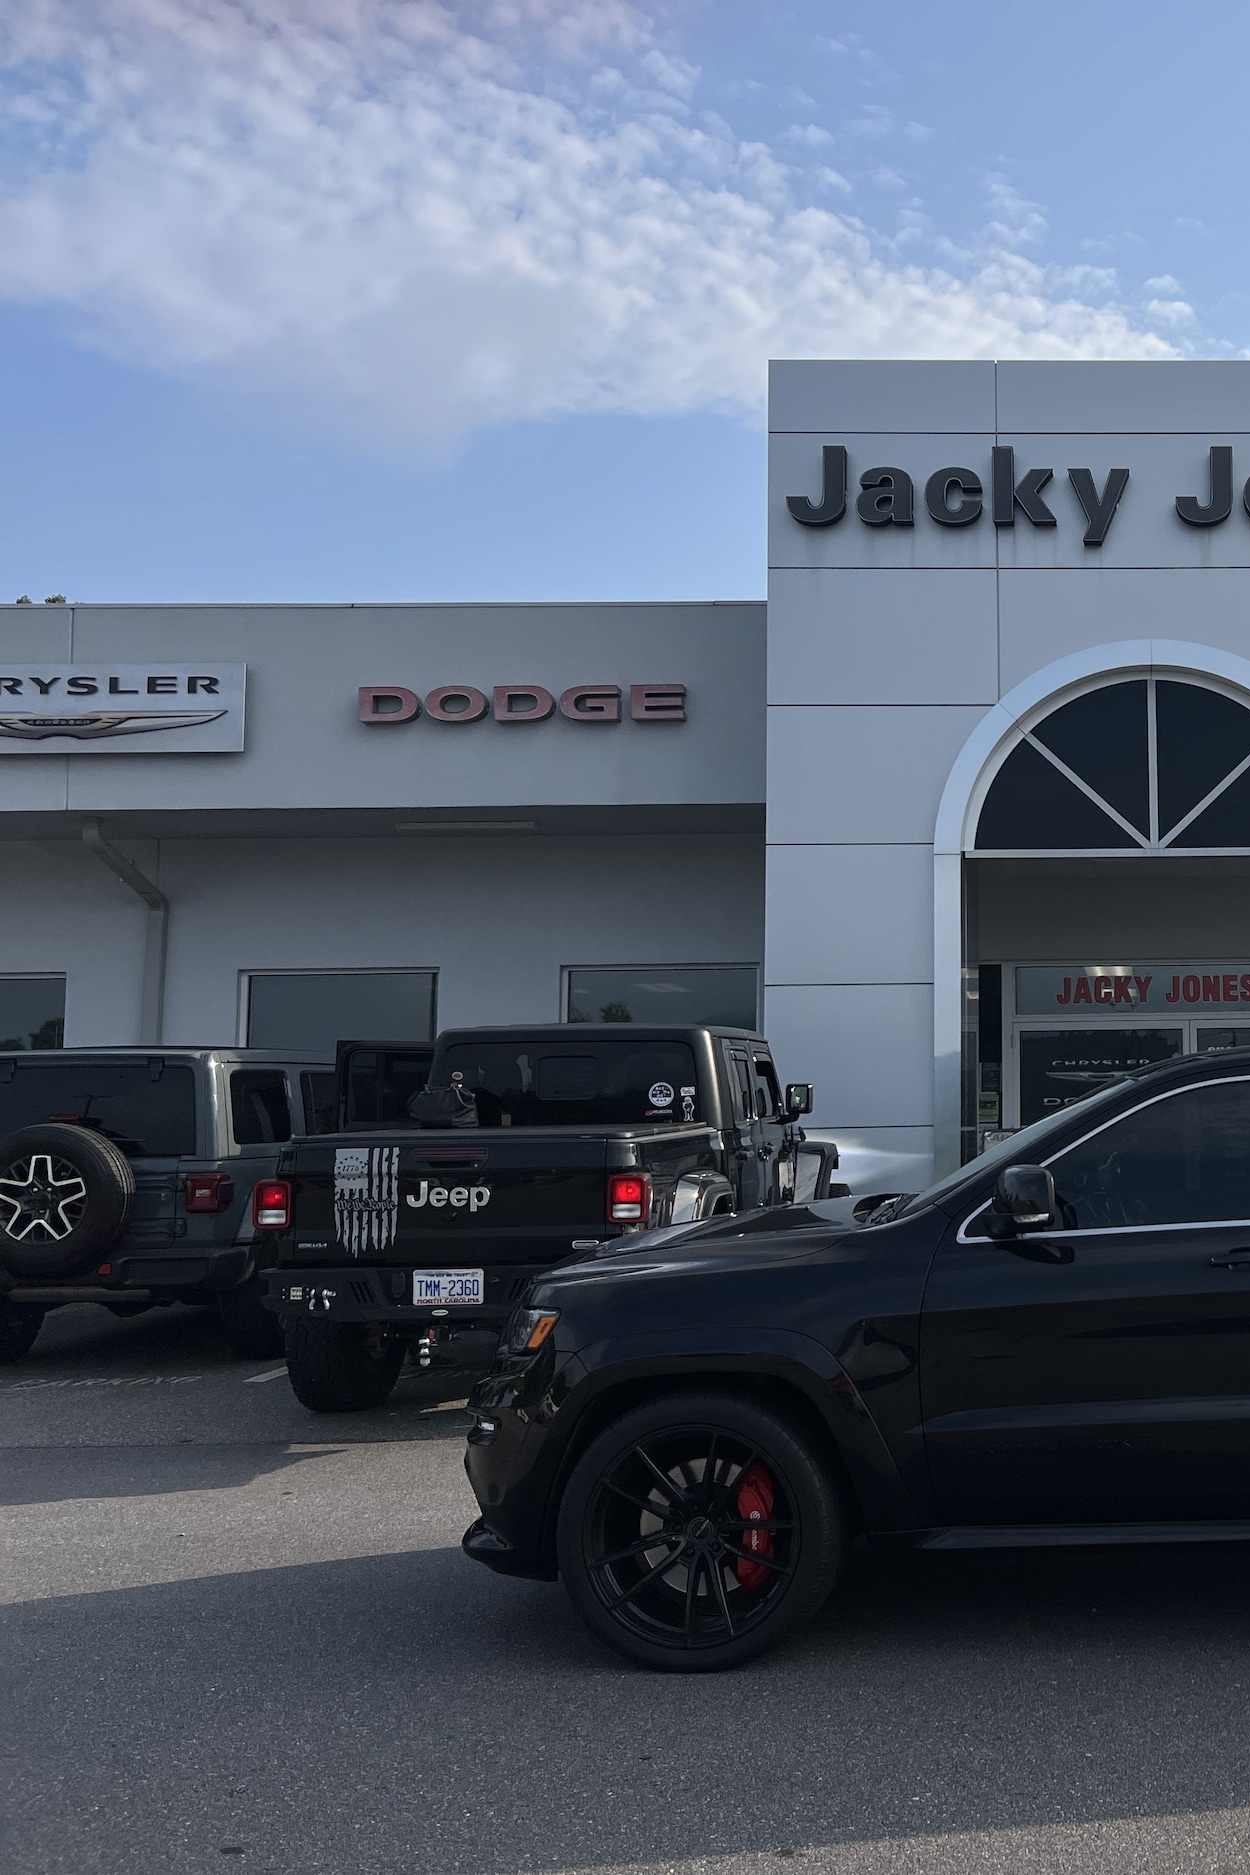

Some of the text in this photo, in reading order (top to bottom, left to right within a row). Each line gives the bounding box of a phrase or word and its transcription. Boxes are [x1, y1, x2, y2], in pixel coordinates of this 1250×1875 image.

[785, 445, 1130, 547] Jacky
[358, 684, 688, 725] DODGE
[1056, 975, 1153, 1005] JACKY
[406, 1180, 490, 1212] Jeep
[417, 1279, 480, 1297] TMM-2360
